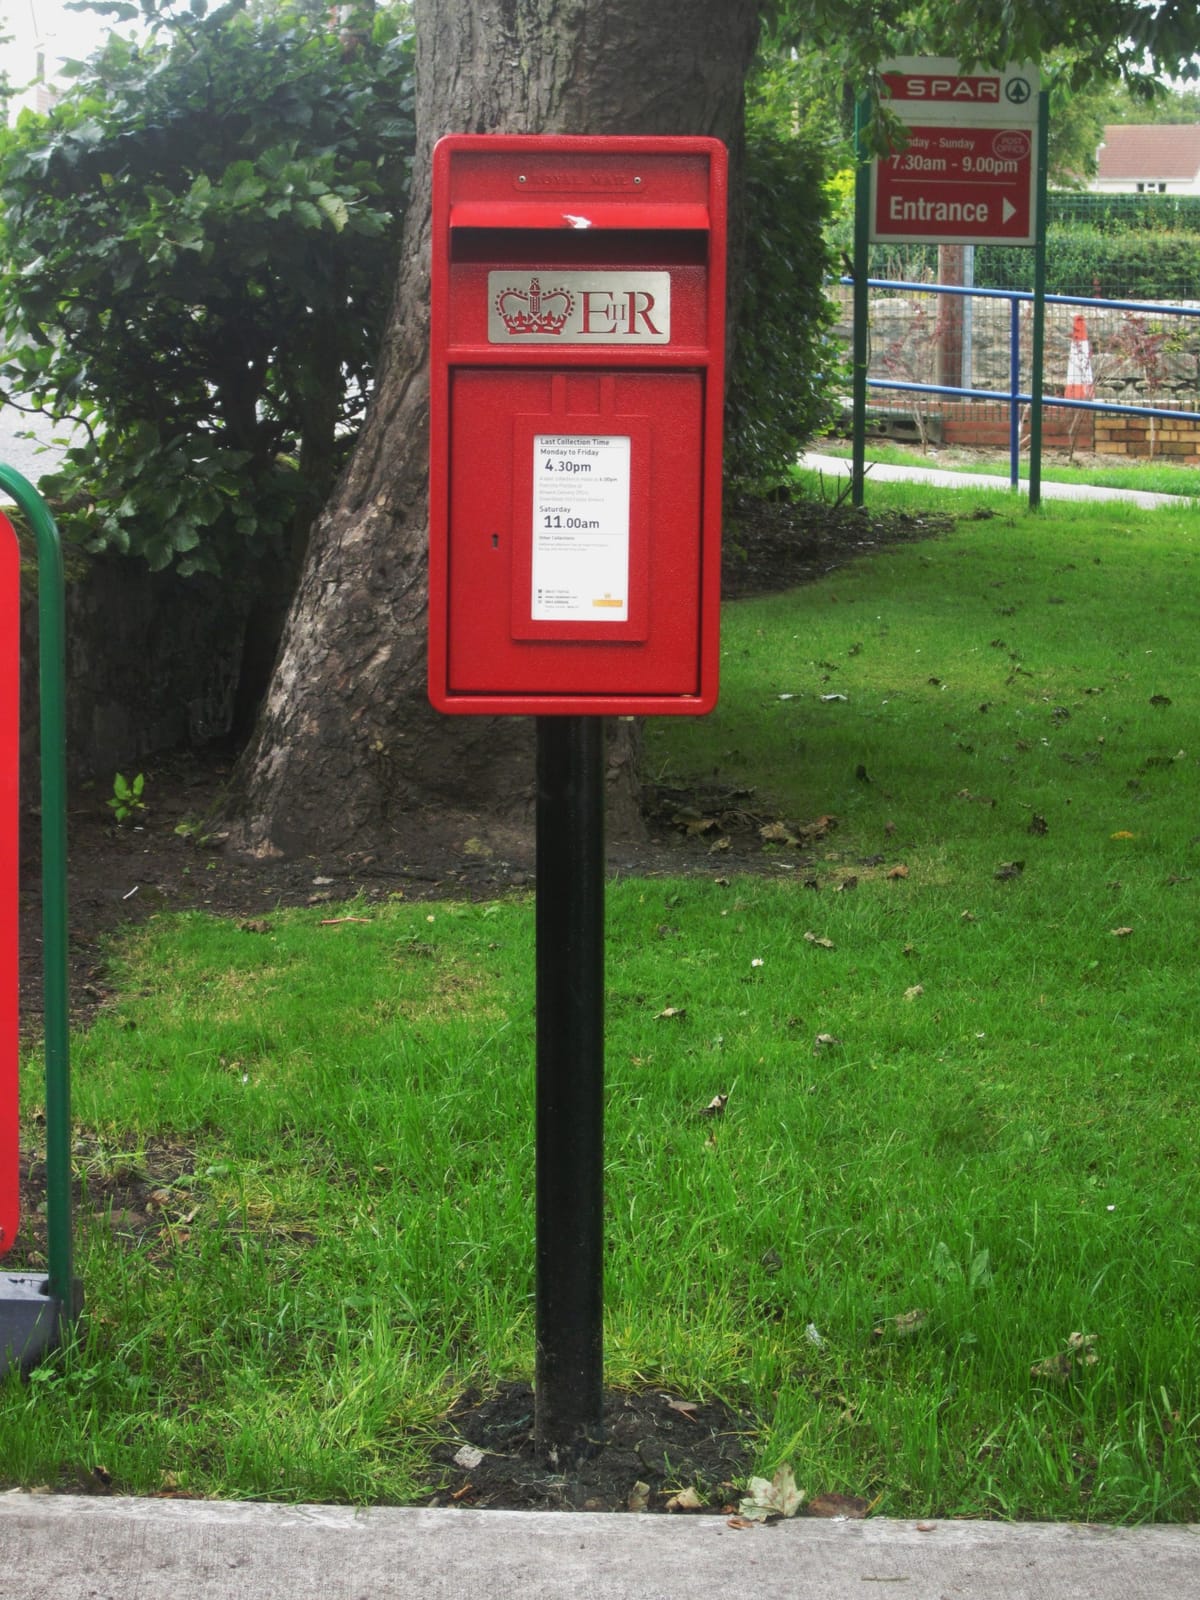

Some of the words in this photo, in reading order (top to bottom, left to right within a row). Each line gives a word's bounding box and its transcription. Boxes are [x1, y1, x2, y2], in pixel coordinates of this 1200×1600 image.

[906, 79, 998, 98] SPAR
[939, 137, 975, 151] Sunday
[891, 154, 946, 171] 7.30am
[962, 156, 1018, 176] 9.00pm
[889, 195, 989, 222] Entrance
[540, 438, 556, 446] Last
[557, 438, 591, 447] Collection
[592, 438, 610, 447] Time
[540, 448, 567, 456] Monday
[577, 448, 599, 457] Friday
[544, 457, 592, 474] 4.30pm
[539, 505, 571, 514] Saturday
[543, 514, 600, 529] 11.00am
